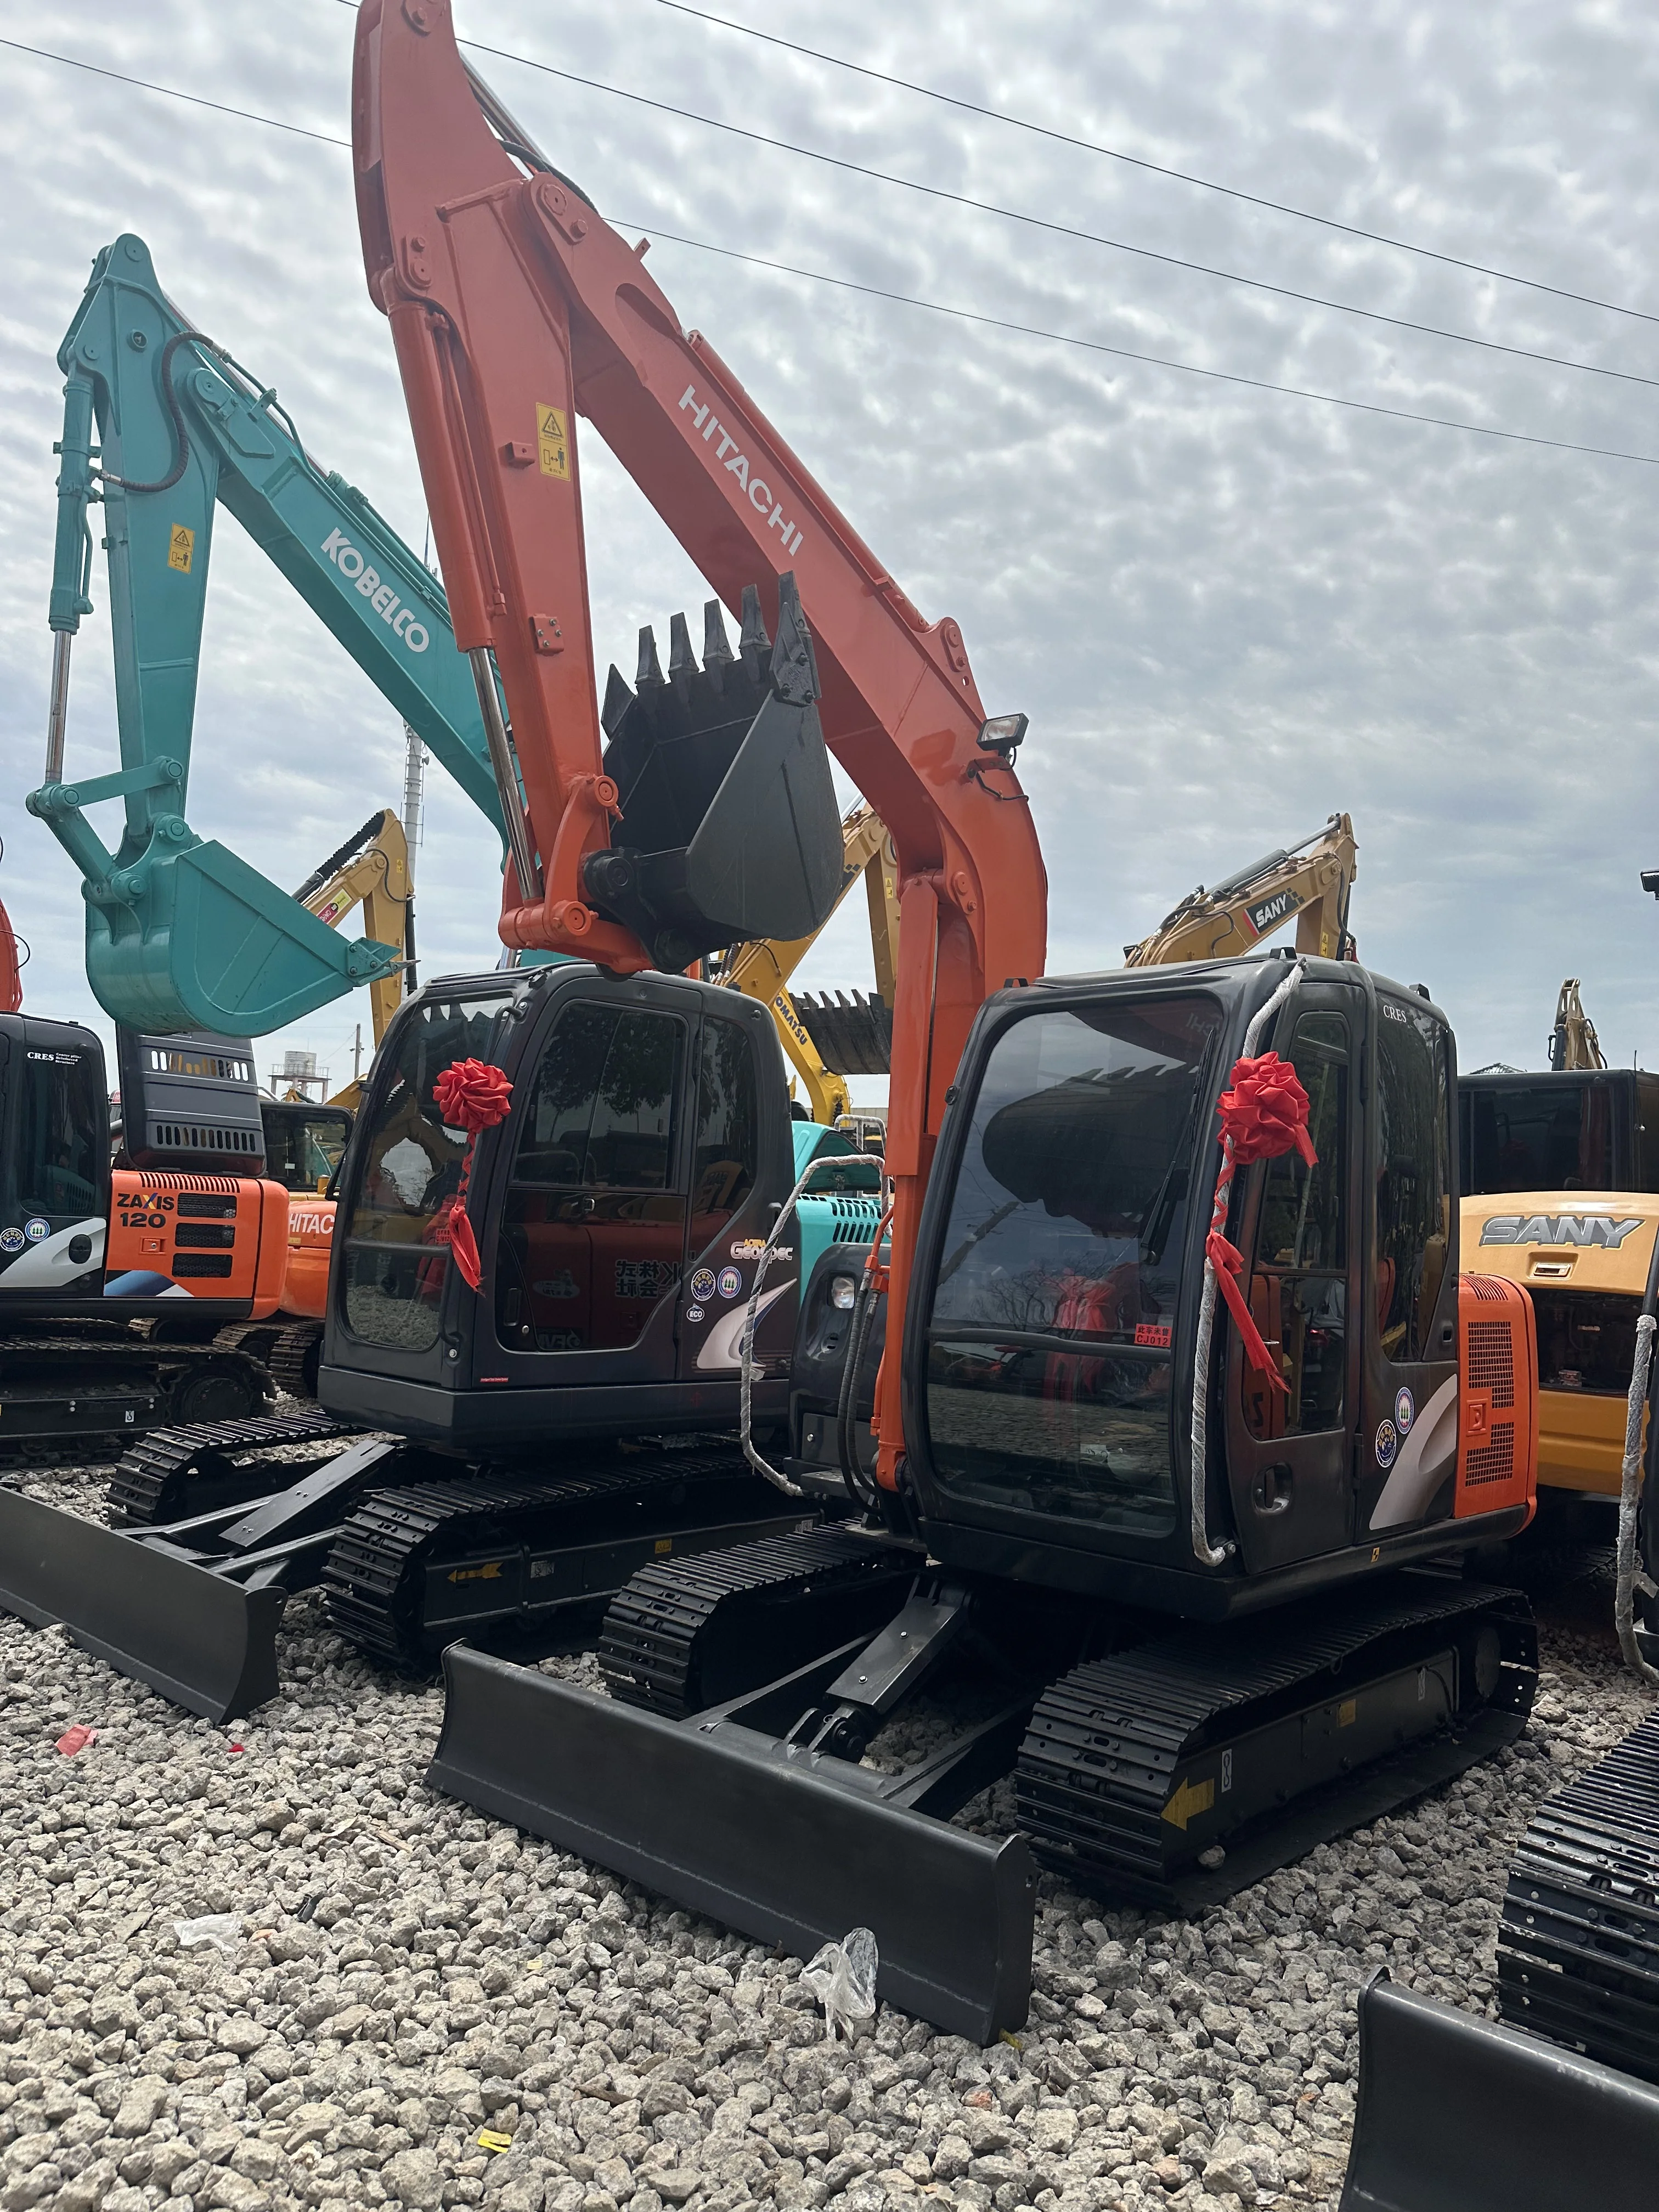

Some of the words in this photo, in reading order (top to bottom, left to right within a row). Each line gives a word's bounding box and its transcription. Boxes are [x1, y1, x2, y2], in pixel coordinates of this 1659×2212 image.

[678, 384, 804, 556] HITACHI
[320, 527, 430, 653] KOBELCO
[1256, 894, 1286, 928] SANY
[776, 996, 808, 1045] OMATSU
[1383, 1005, 1407, 1023] CRES
[27, 1052, 54, 1061] CRES
[117, 1192, 174, 1211] ZAXIS
[120, 1212, 166, 1228] 120
[289, 1213, 335, 1234] HITAC
[1479, 1215, 1645, 1250] SANY
[1137, 1334, 1169, 1346] CJ012
